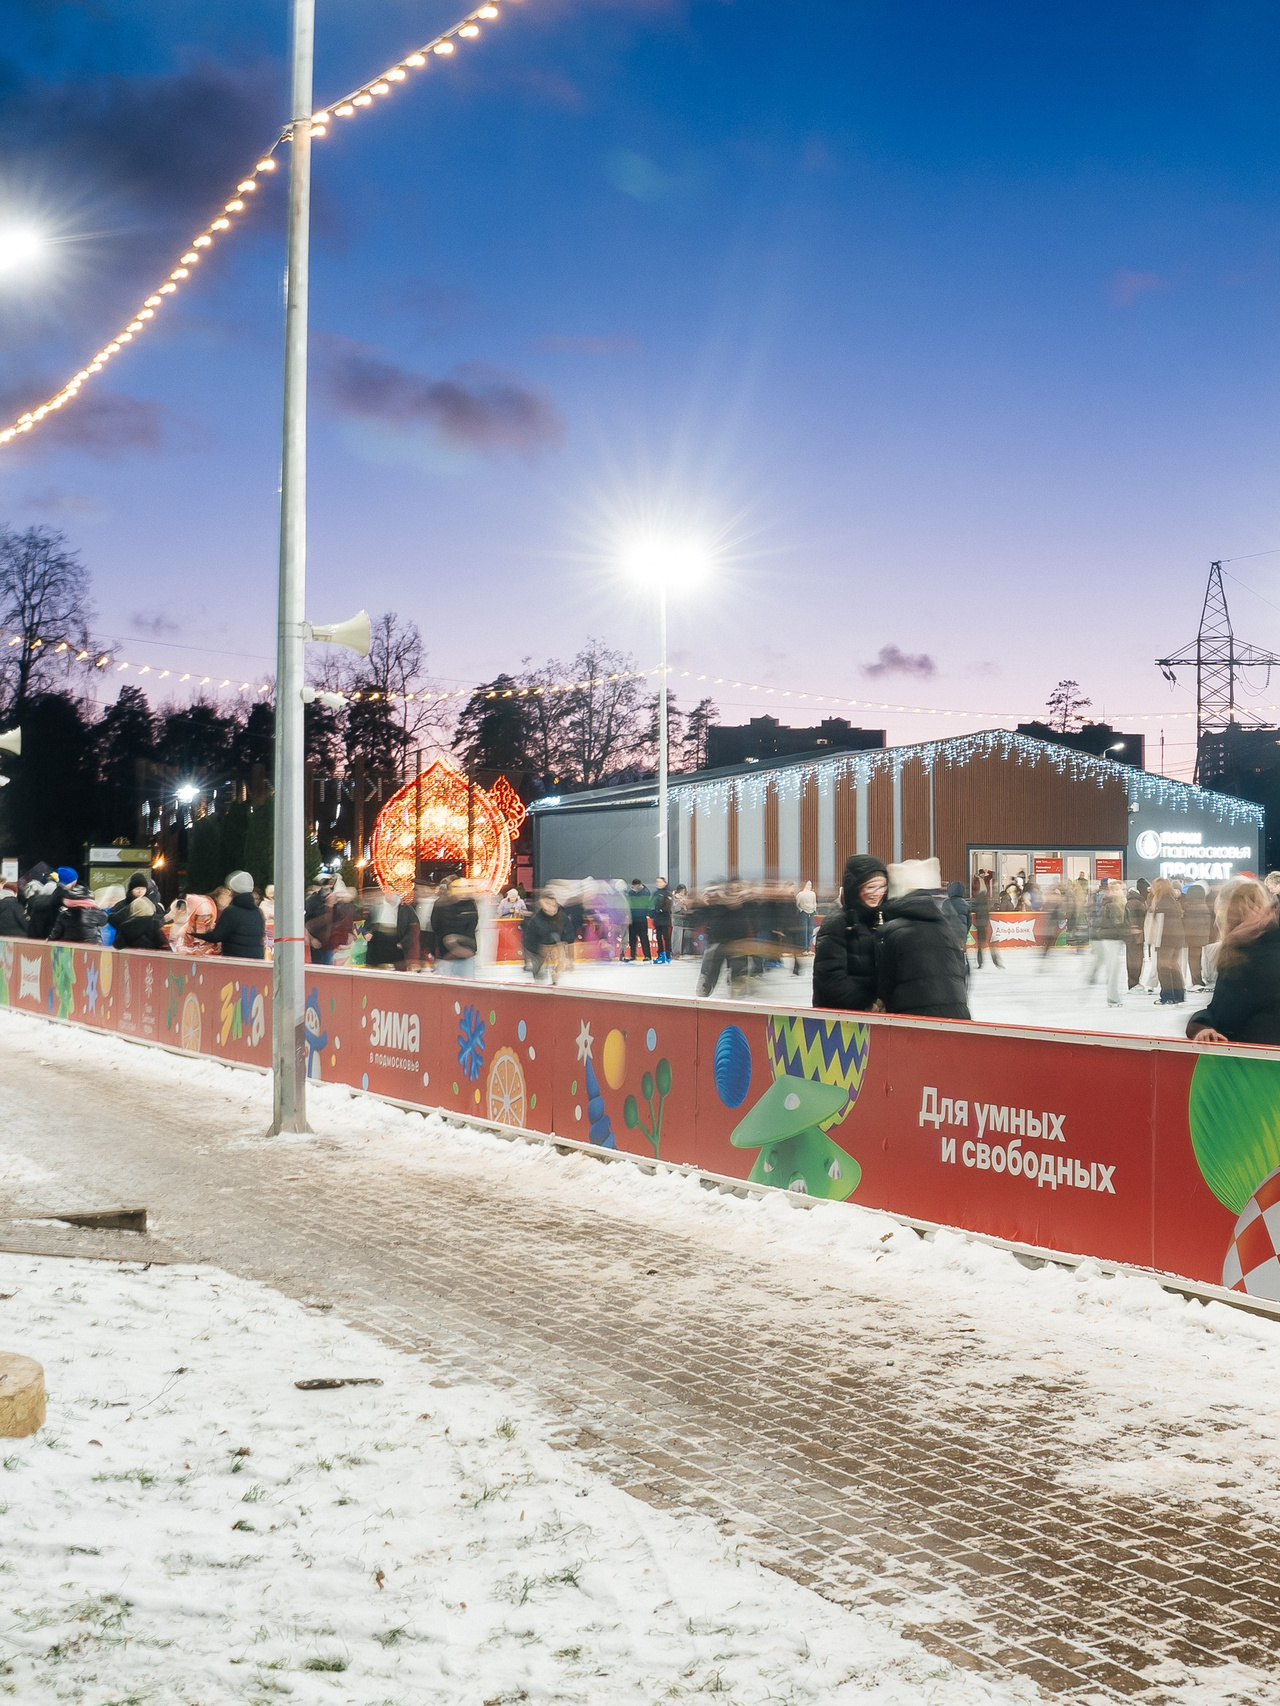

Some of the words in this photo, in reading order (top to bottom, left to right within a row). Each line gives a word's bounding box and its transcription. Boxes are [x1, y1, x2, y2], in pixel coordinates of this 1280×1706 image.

[1160, 846, 1251, 858] ПОДМОСКОВЬЯ
[1160, 862, 1233, 879] ПРОКАТ
[995, 926, 1015, 935] Альфа
[1015, 926, 1031, 935] Банк
[919, 1086, 968, 1129] Для
[974, 1102, 1066, 1142] умных
[941, 1136, 956, 1164] и
[962, 1138, 1116, 1194] свободных
